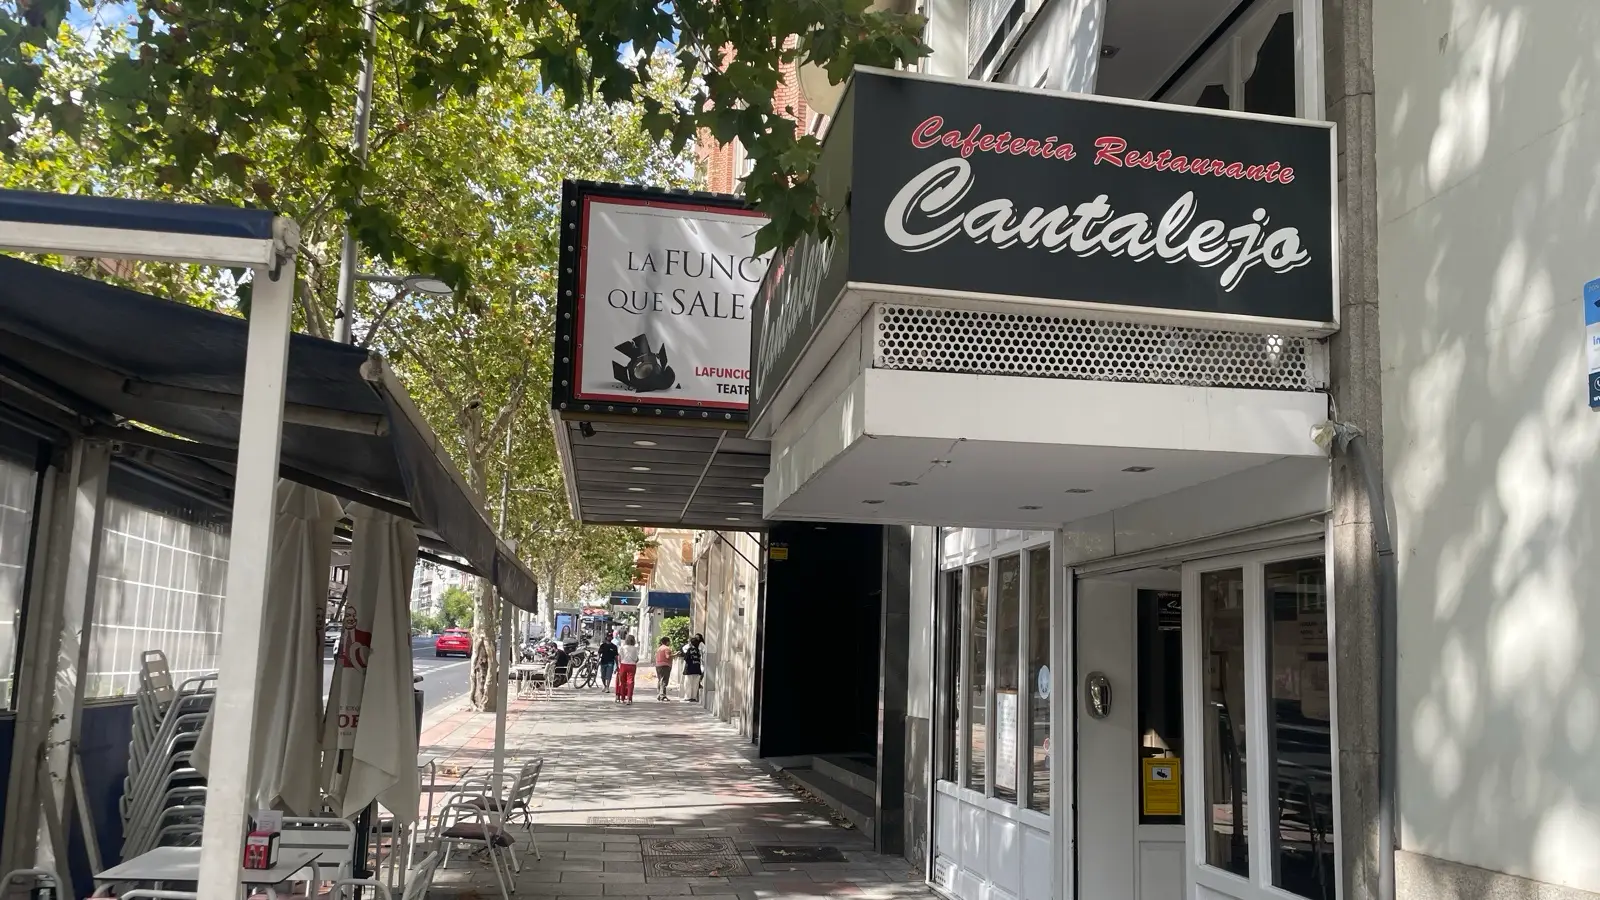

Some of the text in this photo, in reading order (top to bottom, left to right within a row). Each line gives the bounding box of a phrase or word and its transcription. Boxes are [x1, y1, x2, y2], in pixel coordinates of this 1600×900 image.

[911, 115, 1296, 184] Cafetería Restaurante
[884, 157, 1312, 292] Cantalejo
[628, 251, 657, 272] LA
[665, 249, 771, 283] FUNC
[607, 288, 745, 320] QUE SALE
